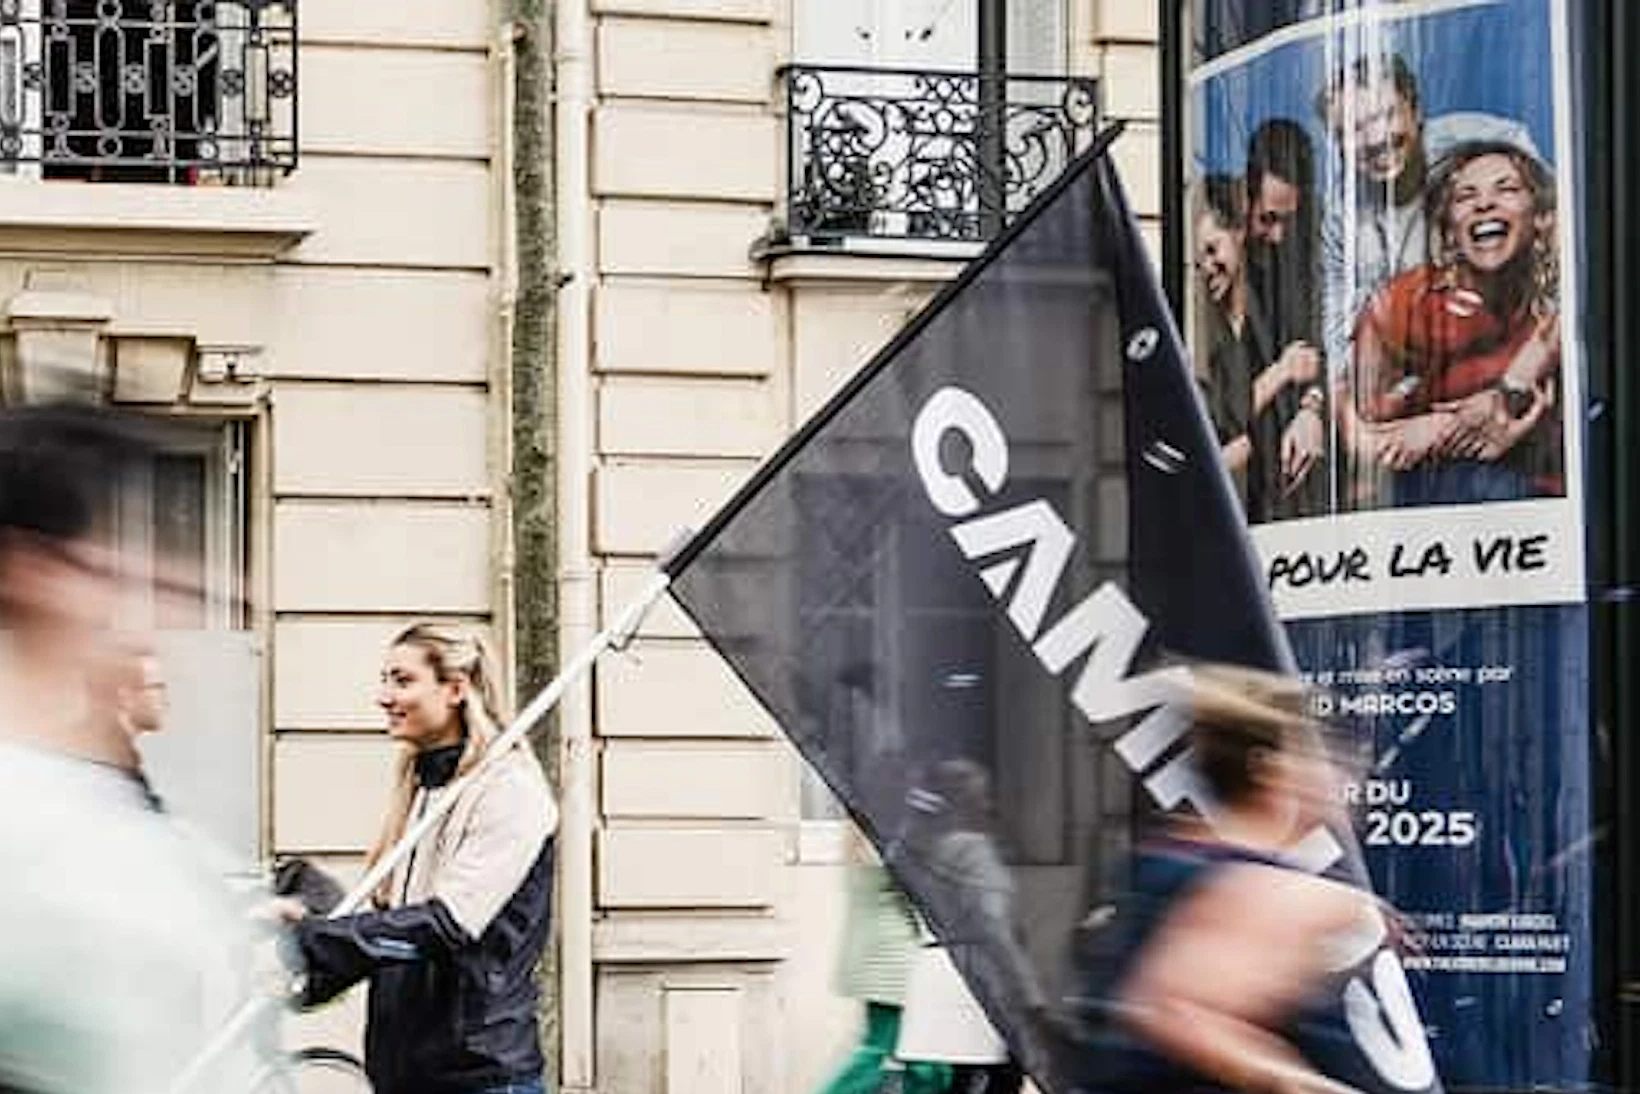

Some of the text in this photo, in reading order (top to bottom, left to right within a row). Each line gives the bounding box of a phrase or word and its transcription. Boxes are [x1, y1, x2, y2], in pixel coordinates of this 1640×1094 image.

[1269, 534, 1549, 589] POUR LA VIE
[1477, 665, 1513, 685] par
[1340, 691, 1456, 715] MARCOS
[1366, 779, 1410, 805] DU
[1365, 811, 1477, 846] 2025
